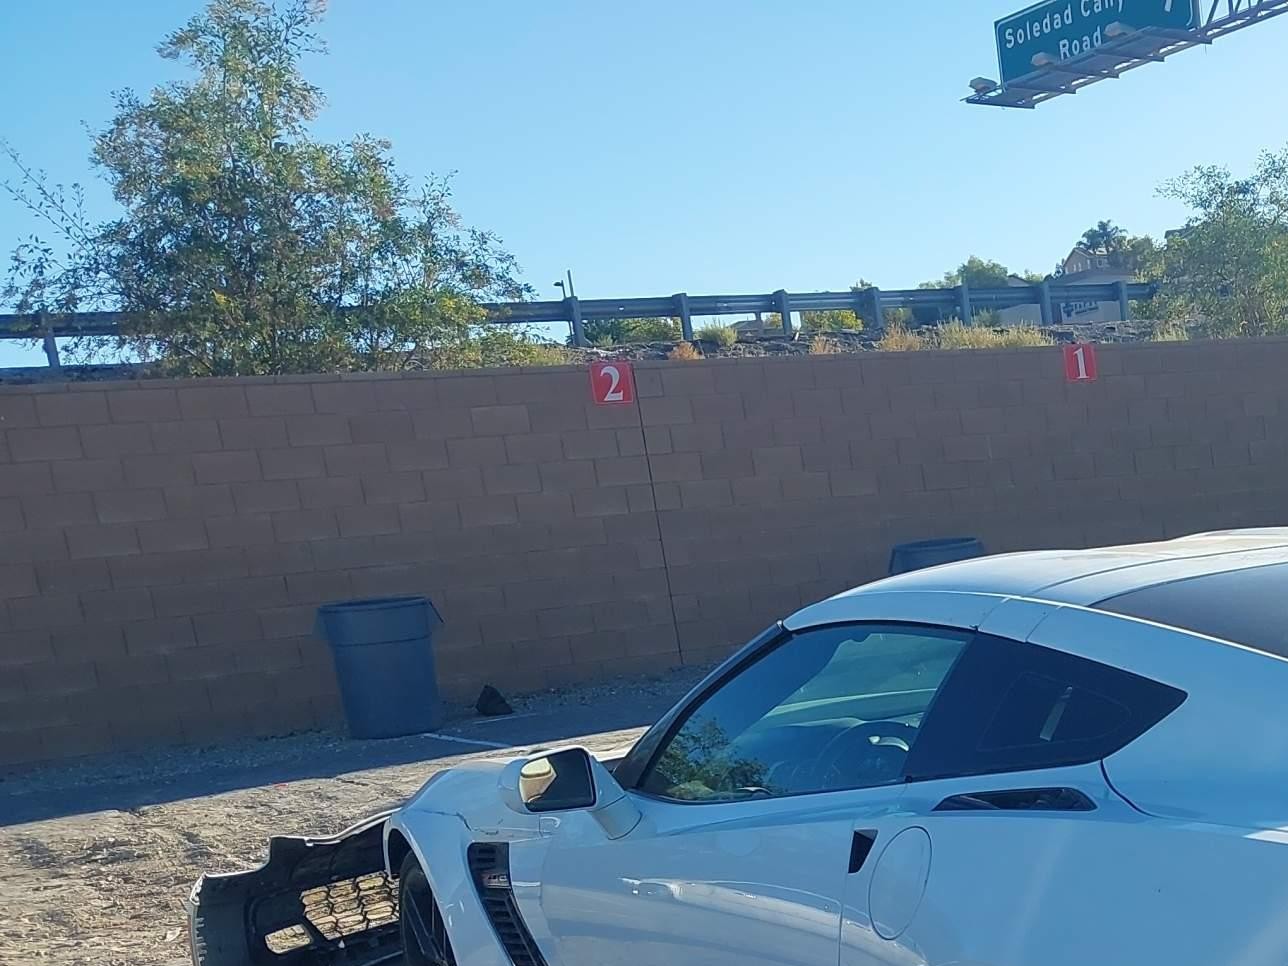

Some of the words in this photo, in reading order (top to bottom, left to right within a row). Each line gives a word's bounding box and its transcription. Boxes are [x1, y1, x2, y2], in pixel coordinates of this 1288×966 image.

[1005, 3, 1073, 49] Soledad
[1059, 25, 1102, 60] Road
[1073, 347, 1090, 379] 1
[600, 365, 624, 401] 2
